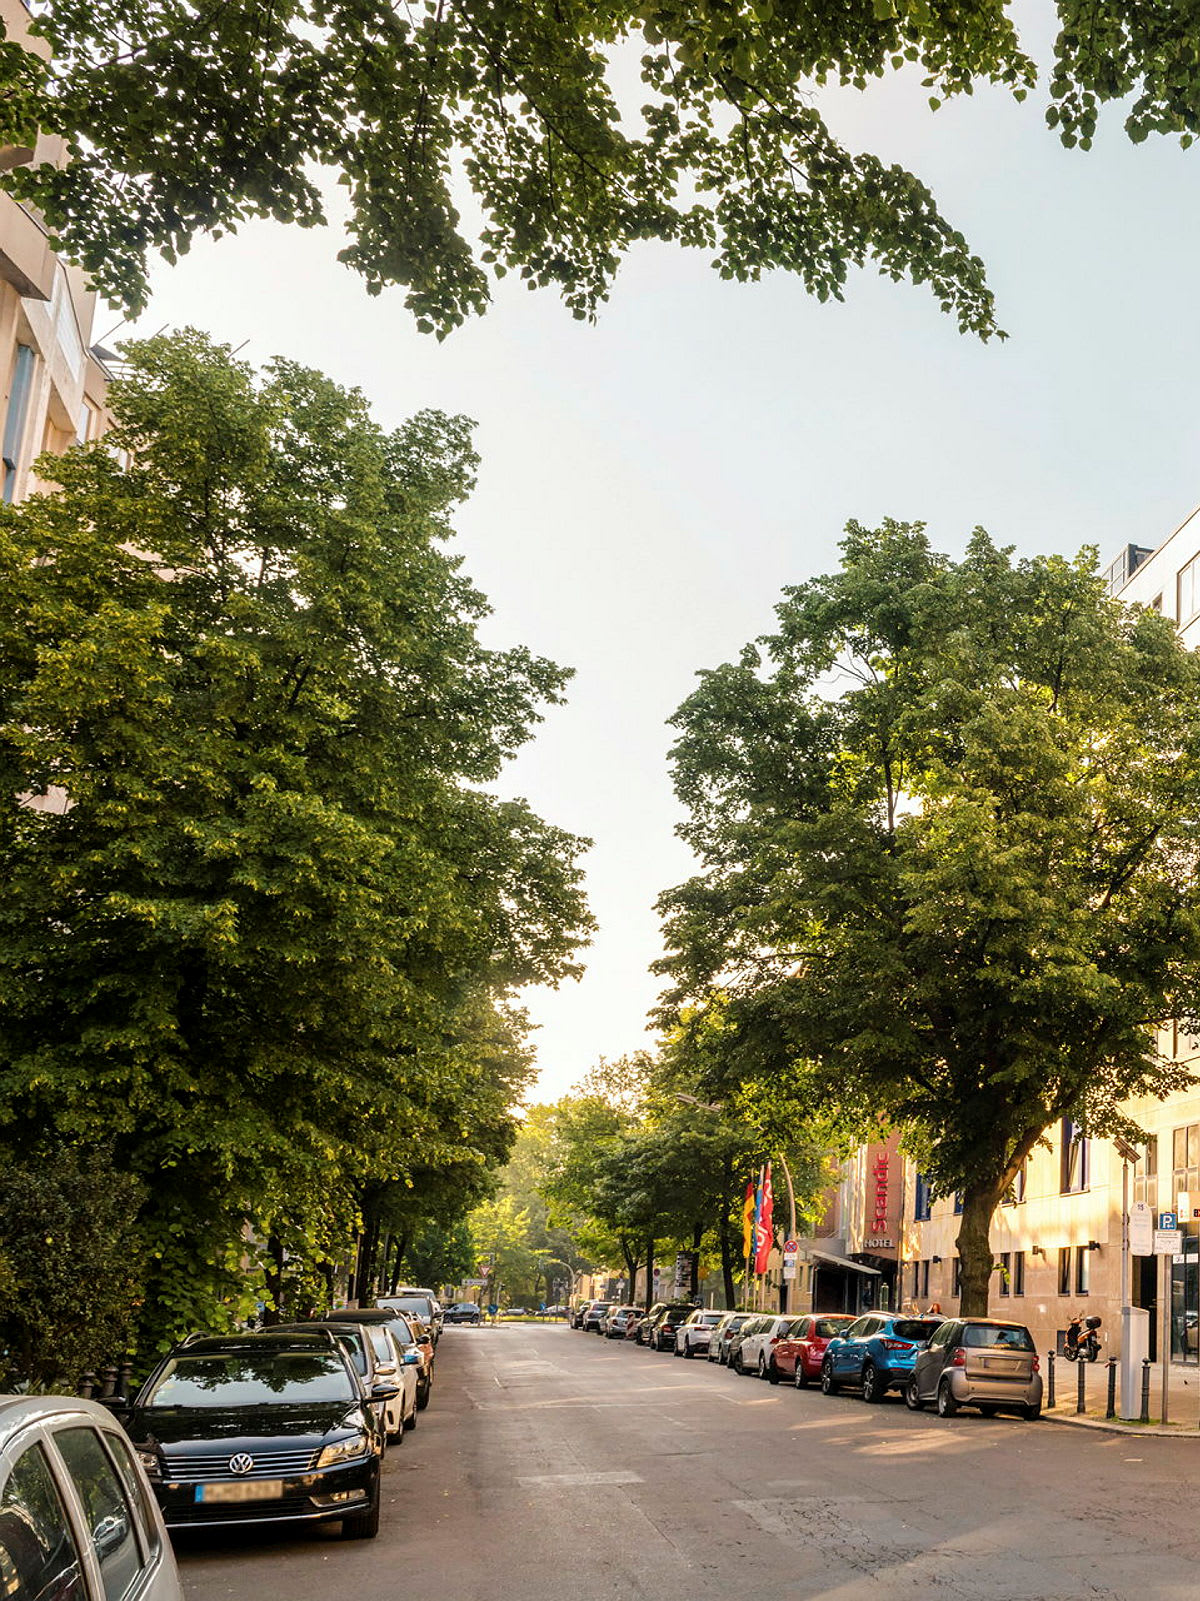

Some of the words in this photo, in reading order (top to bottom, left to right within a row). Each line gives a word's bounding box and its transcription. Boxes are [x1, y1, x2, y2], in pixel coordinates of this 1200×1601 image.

[872, 1152, 889, 1233] Scandic
[1162, 1215, 1173, 1229] P
[864, 1239, 894, 1248] HOTEL
